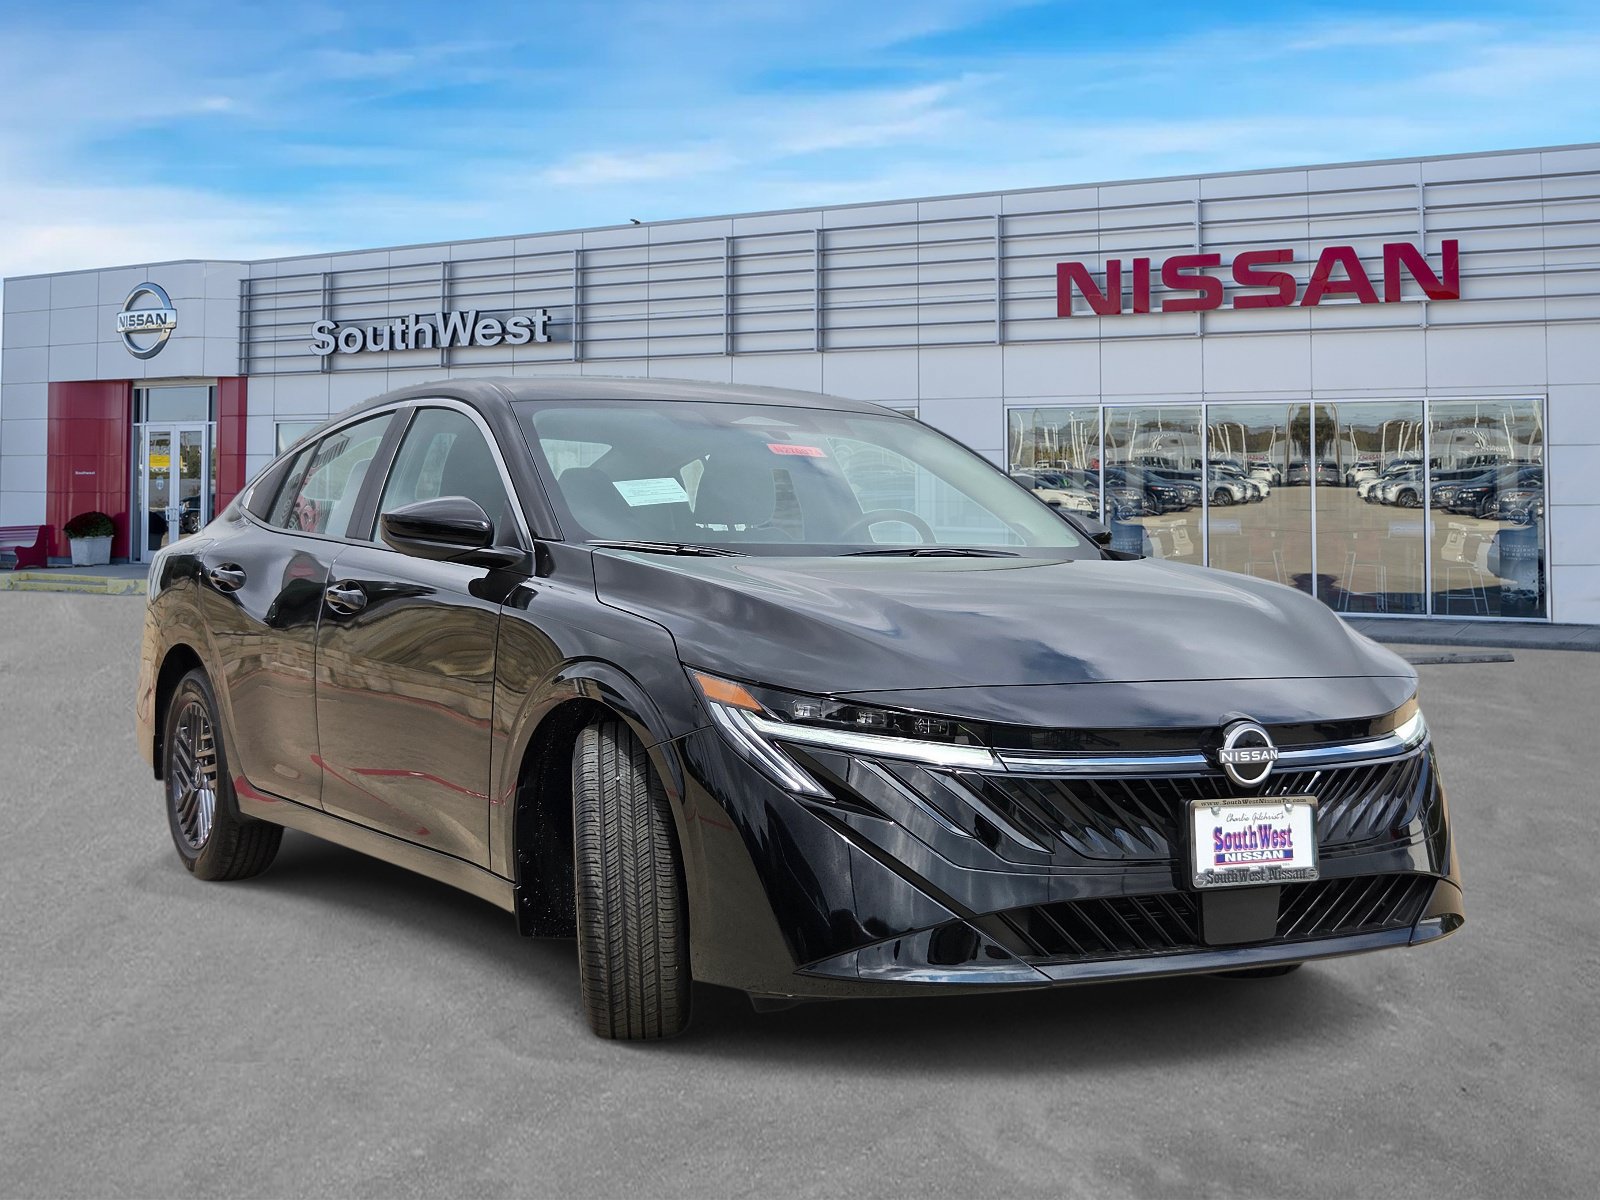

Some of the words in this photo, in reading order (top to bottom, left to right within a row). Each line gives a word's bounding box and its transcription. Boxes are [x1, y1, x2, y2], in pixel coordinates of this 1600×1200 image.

[1056, 239, 1461, 318] NISSAN
[117, 310, 170, 331] NISSAN
[310, 308, 552, 357] SouthWest
[1220, 749, 1279, 763] NISSAN
[1212, 823, 1294, 853] SouthWest
[1224, 849, 1284, 862] NISSAN
[1206, 866, 1266, 884] SouthWest
[1268, 866, 1307, 881] Nissan
